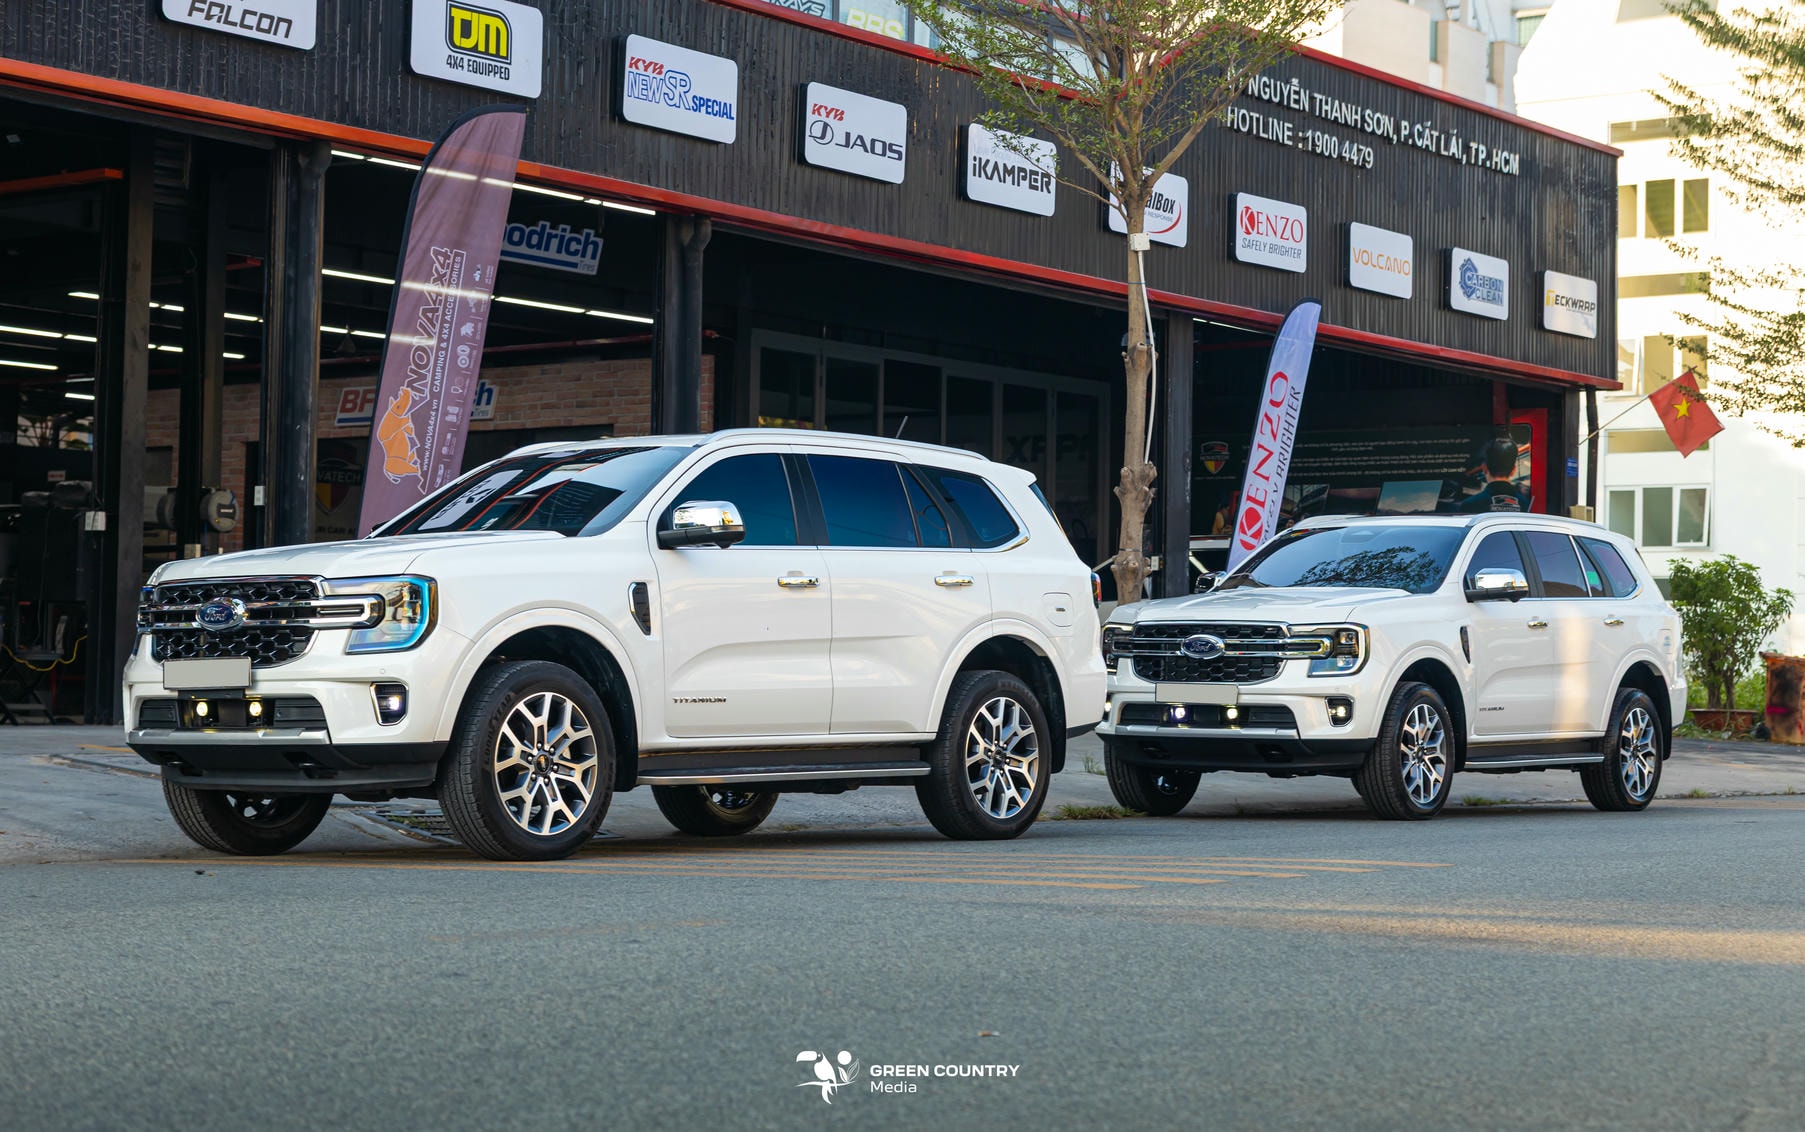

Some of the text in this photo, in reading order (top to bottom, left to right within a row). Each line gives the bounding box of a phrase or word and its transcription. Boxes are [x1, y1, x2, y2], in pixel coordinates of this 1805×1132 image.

[187, 0, 293, 39] FALCON
[450, 6, 508, 58] TJM
[446, 54, 510, 80] 4X4 EQUIPPED
[629, 56, 664, 75] KYB
[627, 70, 664, 104] NEW
[691, 94, 735, 121] SPECIAL
[811, 103, 845, 121] KYB
[1313, 92, 1361, 129] THANH
[834, 131, 903, 162] JAOS
[1226, 105, 1293, 146] HOTLINE
[1341, 140, 1374, 169] 4479
[972, 155, 1052, 194] iKAMPER
[502, 223, 600, 260] odrich
[1240, 205, 1304, 244] KENZO
[1241, 237, 1302, 259] SAFELY BRIGHTER
[1352, 247, 1411, 277] VOLCANO
[444, 256, 461, 321] ACCESORIES
[1465, 271, 1504, 292] CARBON
[1475, 287, 1504, 305] CLEAN
[441, 322, 450, 340] 4X4
[432, 350, 446, 393] CAMPING
[318, 469, 362, 483] VATECH
[1238, 370, 1289, 551] KENZO
[671, 696, 728, 704] TITANIUM
